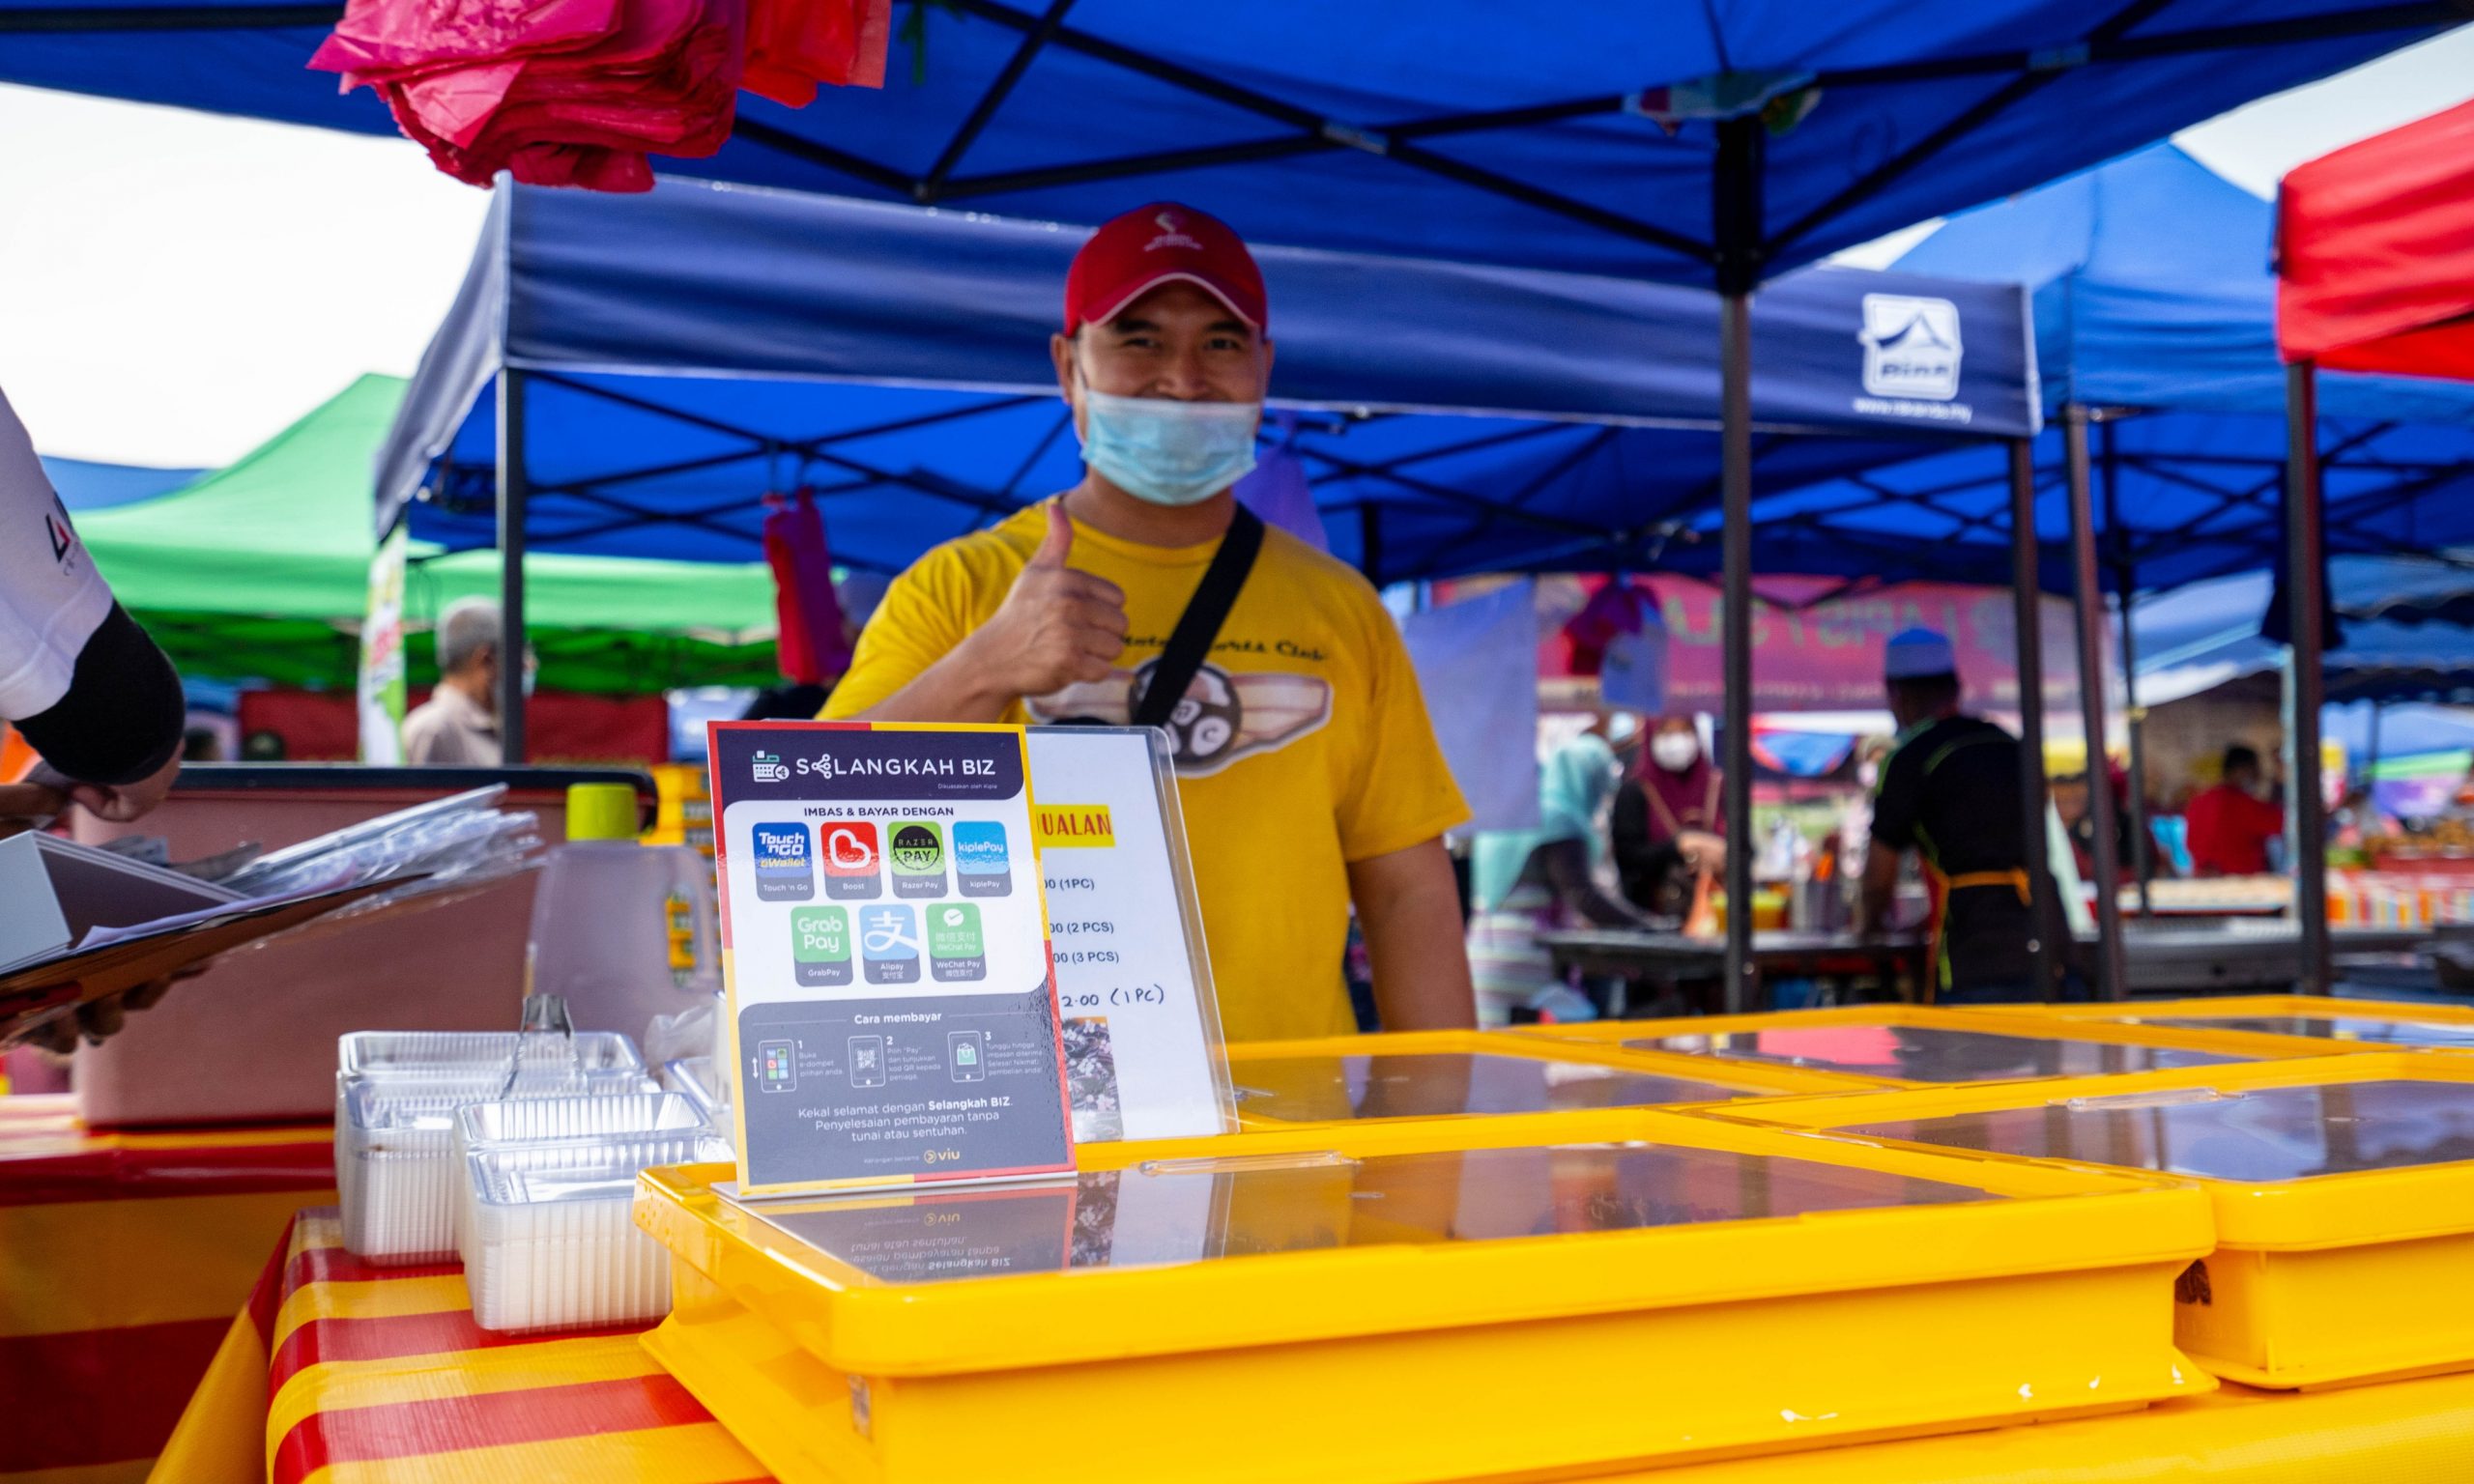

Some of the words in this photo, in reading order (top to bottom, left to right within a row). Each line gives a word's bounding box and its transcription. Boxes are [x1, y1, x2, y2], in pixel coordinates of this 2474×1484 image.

[962, 758, 996, 776] BIZ
[804, 807, 843, 816] IMBAS
[847, 807, 854, 816] &
[858, 807, 899, 816] BAYAR
[903, 807, 954, 816] DENGAN
[1036, 813, 1112, 836] UALAN
[759, 832, 805, 844] Touch
[958, 842, 1004, 853] kiplePay
[904, 850, 931, 862] PAY
[763, 883, 787, 892] Touch
[796, 883, 808, 892] Go
[843, 882, 865, 891] Boost
[925, 880, 938, 890] Pay
[969, 880, 1000, 889] kiplePay
[1059, 877, 1095, 891] (1PC)
[797, 915, 843, 933] Grab
[1082, 922, 1114, 934] PCS)
[803, 934, 840, 954] Pay
[964, 943, 976, 952] Pay
[1087, 951, 1120, 964] PCS)
[880, 962, 904, 972] Alipay
[936, 960, 965, 969] WeChat
[966, 959, 981, 969] Pay
[808, 968, 841, 977] GrabPay
[854, 1014, 880, 1024] Cara
[883, 1013, 942, 1023] membayar
[886, 1036, 893, 1045] 2
[985, 1031, 992, 1041] 3
[797, 1040, 803, 1049] 1
[798, 1107, 830, 1119] Kekal
[833, 1104, 878, 1117] selamat
[882, 1102, 926, 1114] dengan
[928, 1098, 987, 1111] Selangkah
[816, 1118, 890, 1131] Penyelesaian
[894, 1113, 964, 1127] pembayaran
[967, 1111, 999, 1123] tanpa
[851, 1130, 880, 1142] tunai
[884, 1129, 909, 1140] atau
[912, 1126, 967, 1138] sentuhan.
[937, 1148, 961, 1161] viu
